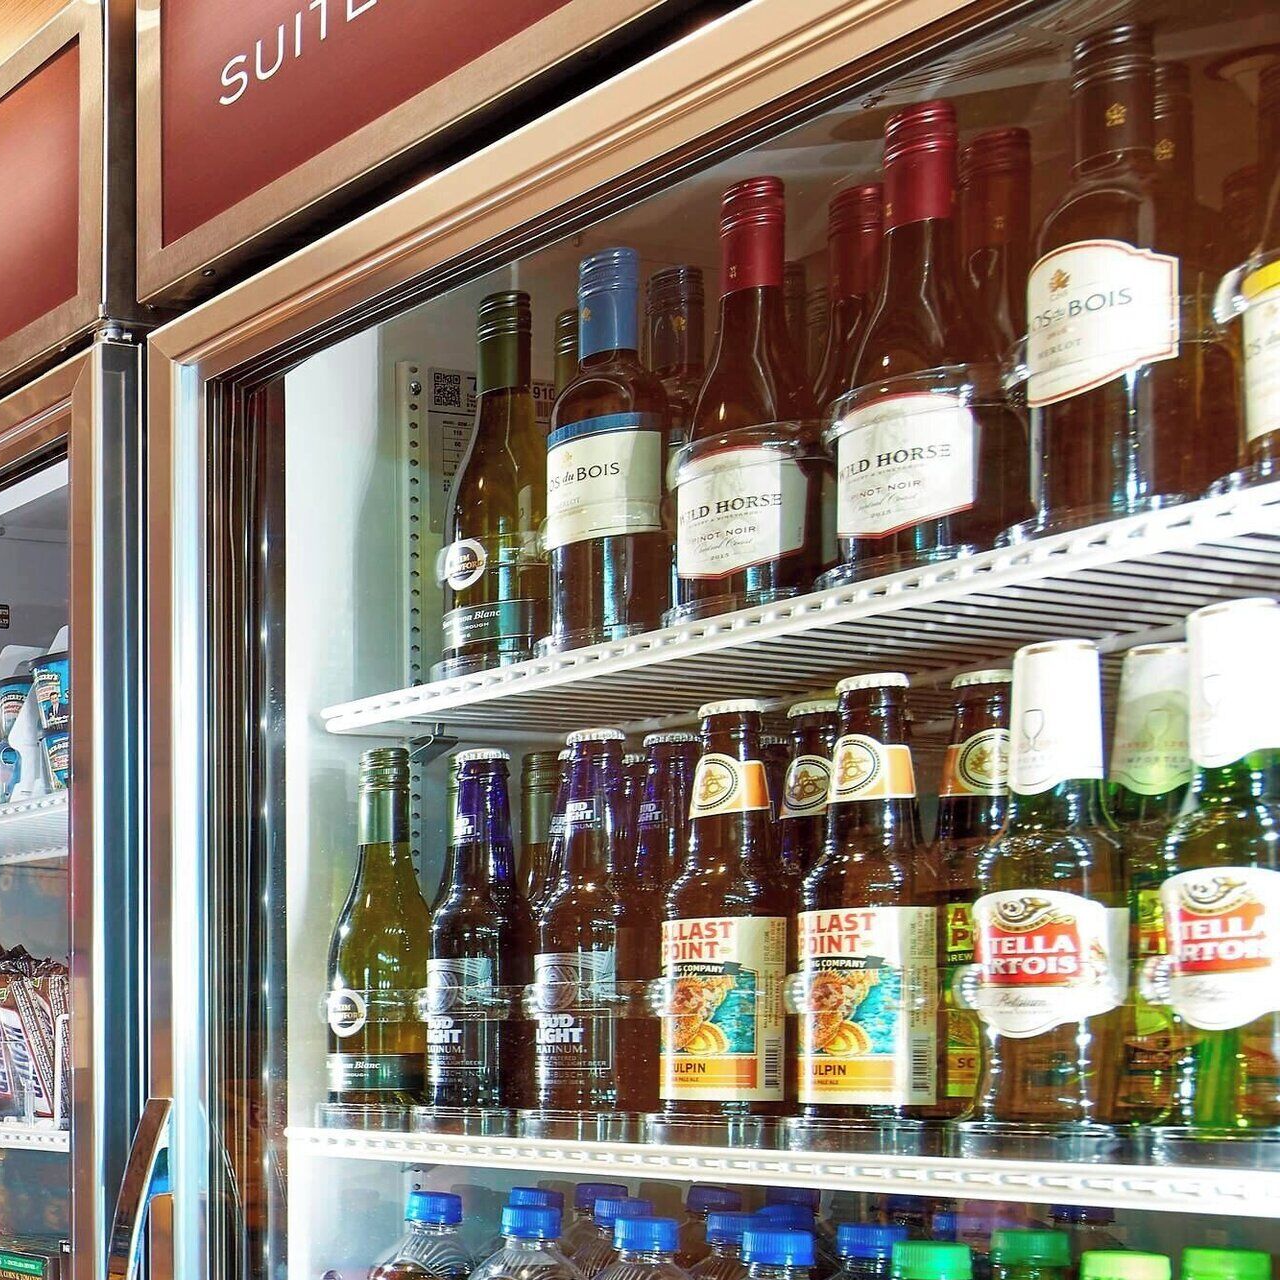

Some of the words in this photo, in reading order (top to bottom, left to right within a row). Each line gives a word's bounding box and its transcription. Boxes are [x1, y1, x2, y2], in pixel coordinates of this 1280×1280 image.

[1067, 287, 1133, 319] BOIS
[876, 442, 952, 468] HORSE
[576, 461, 620, 482] BOIS
[716, 491, 782, 514] HORSE
[722, 524, 757, 539] NOIR
[473, 609, 501, 620] Blanc
[989, 936, 1075, 956] TELLA
[683, 962, 725, 975] COMPANY
[990, 956, 1078, 977] RTOIS
